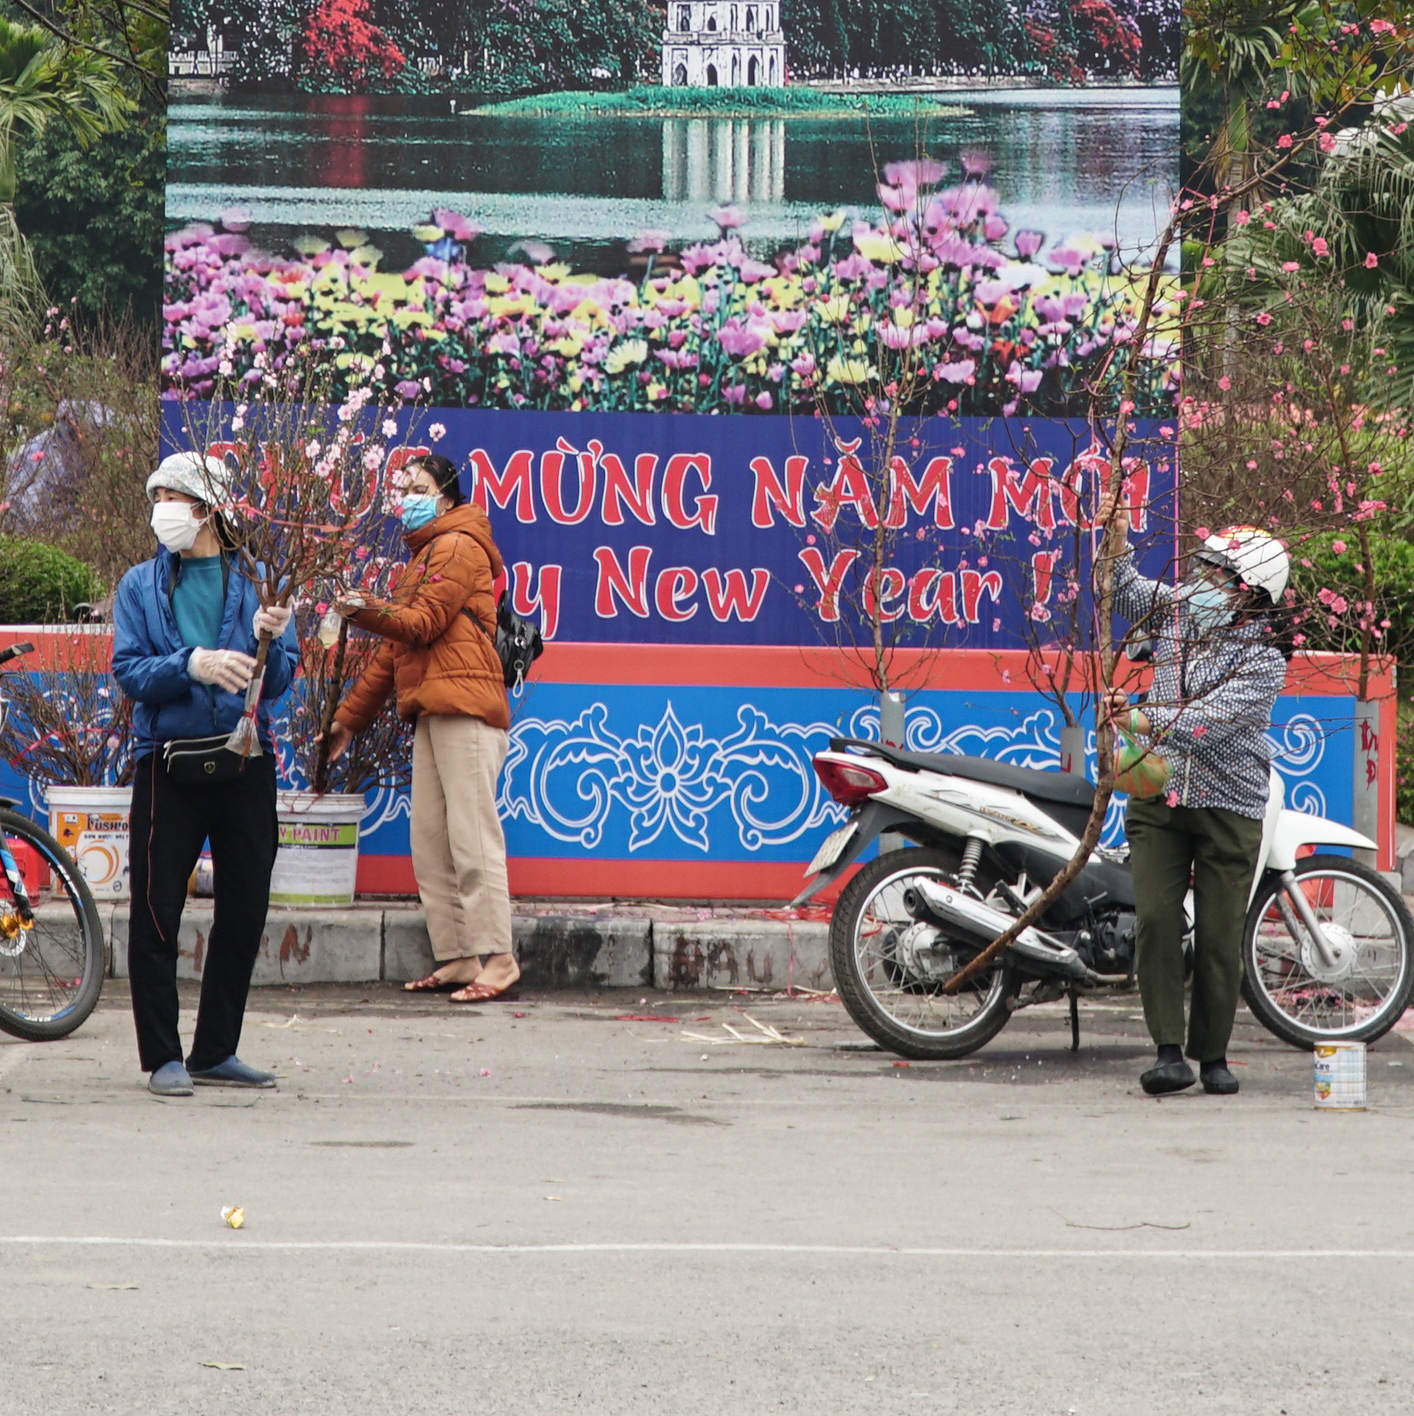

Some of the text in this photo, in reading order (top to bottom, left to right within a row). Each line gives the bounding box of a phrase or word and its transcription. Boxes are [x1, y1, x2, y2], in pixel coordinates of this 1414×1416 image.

[469, 436, 719, 535] MỪNG
[749, 436, 956, 530] NĂM
[593, 545, 770, 622] New
[798, 547, 1003, 624] Year
[293, 827, 341, 842] PAINT
